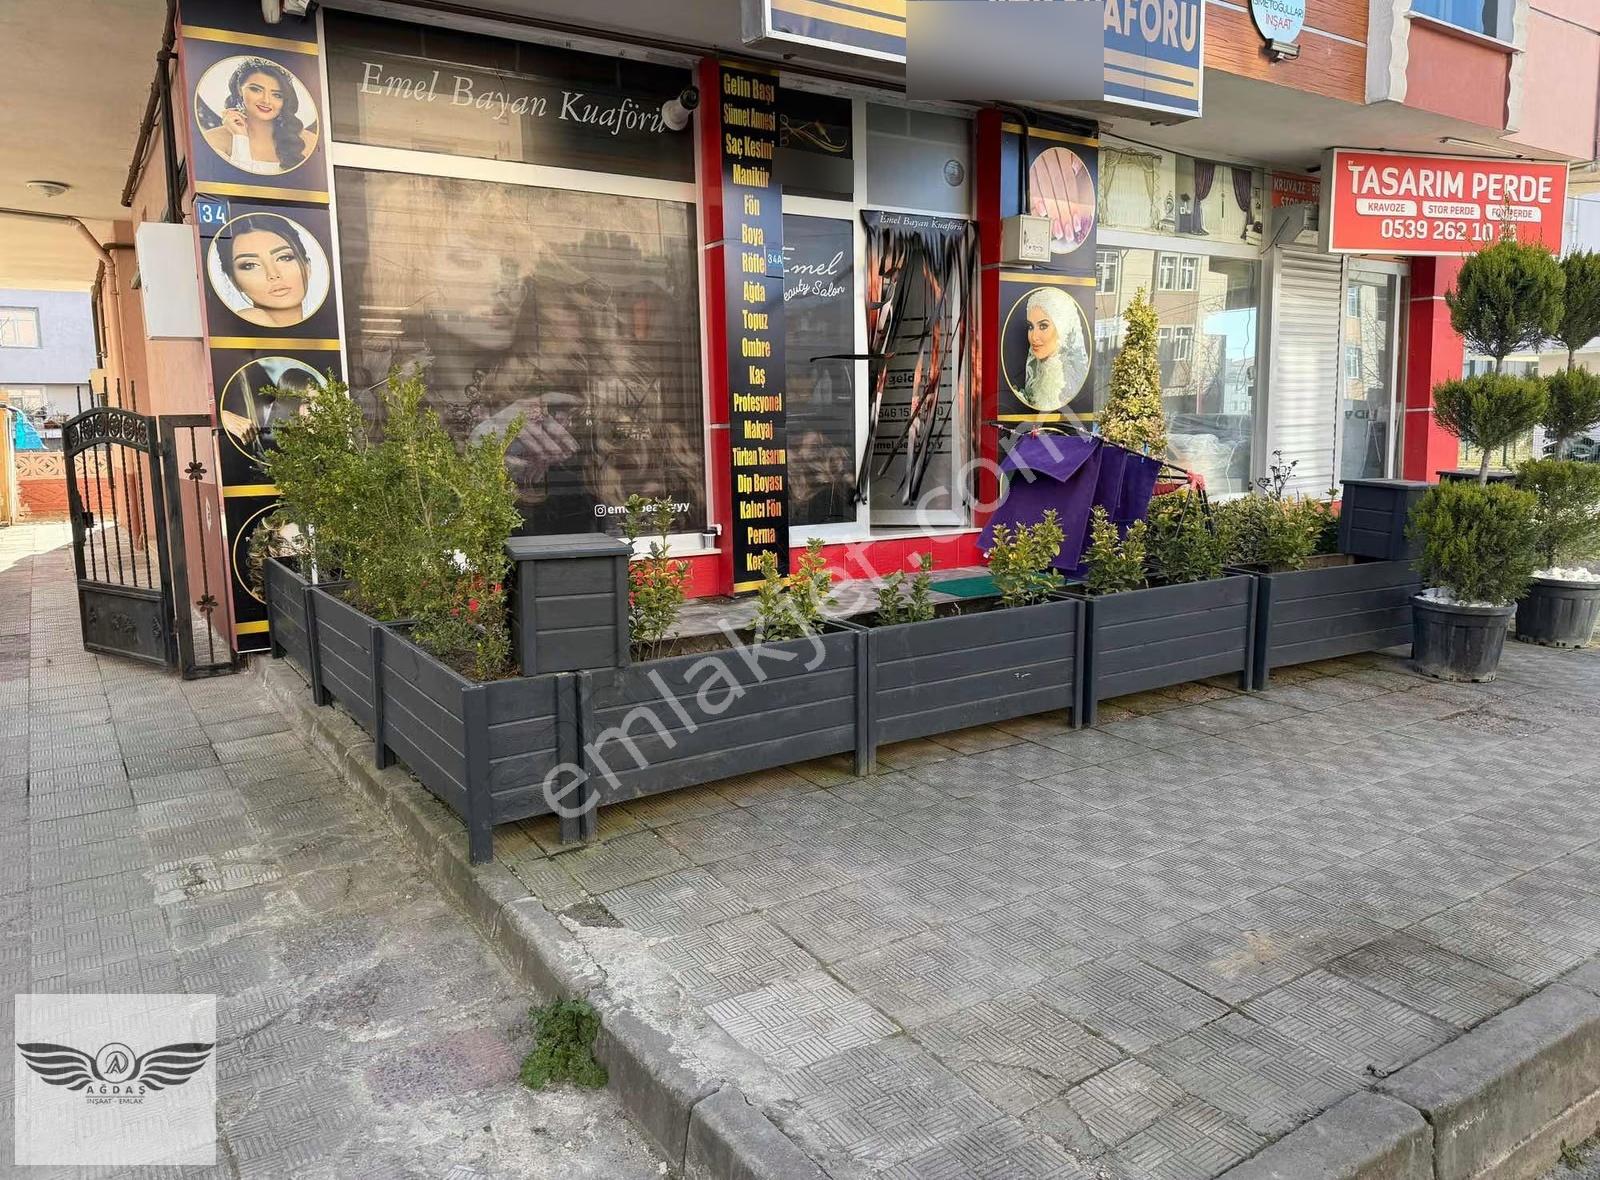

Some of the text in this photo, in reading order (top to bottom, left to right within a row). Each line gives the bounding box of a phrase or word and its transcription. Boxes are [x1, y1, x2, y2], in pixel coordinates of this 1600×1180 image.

[360, 62, 667, 135] Emel Bayan Kuaförü
[724, 73, 775, 105] Gelin Başı
[724, 103, 776, 132] Sünnet Annesi
[726, 132, 775, 160] Saç Kesim
[733, 163, 770, 188] Manikür
[1347, 165, 1553, 204] TASARIM PERDE
[203, 205, 227, 224] 34
[744, 194, 760, 216] Fön
[1368, 202, 1406, 212] KRAVOZE
[1428, 204, 1475, 215] STOR PERDE
[880, 214, 901, 225] Emel
[903, 216, 929, 228] Bayan
[1381, 219, 1428, 240] 0539
[1433, 220, 1467, 240] 262
[1472, 222, 1493, 241] 10
[741, 223, 764, 247] Boya
[741, 252, 766, 274] Röfle
[767, 253, 783, 264] 34A
[743, 280, 766, 304] Ağda
[784, 279, 845, 301] eauty Salon
[742, 309, 768, 331] Topuz
[741, 337, 771, 358] Ombre
[749, 365, 766, 389] Kaş
[733, 392, 782, 413] Profesyonel
[744, 420, 773, 440] Makyaj
[733, 447, 758, 467] Türban
[737, 473, 783, 496] Dip Boyası
[740, 498, 782, 520] Kalıcı Fön
[747, 527, 775, 545] Perma
